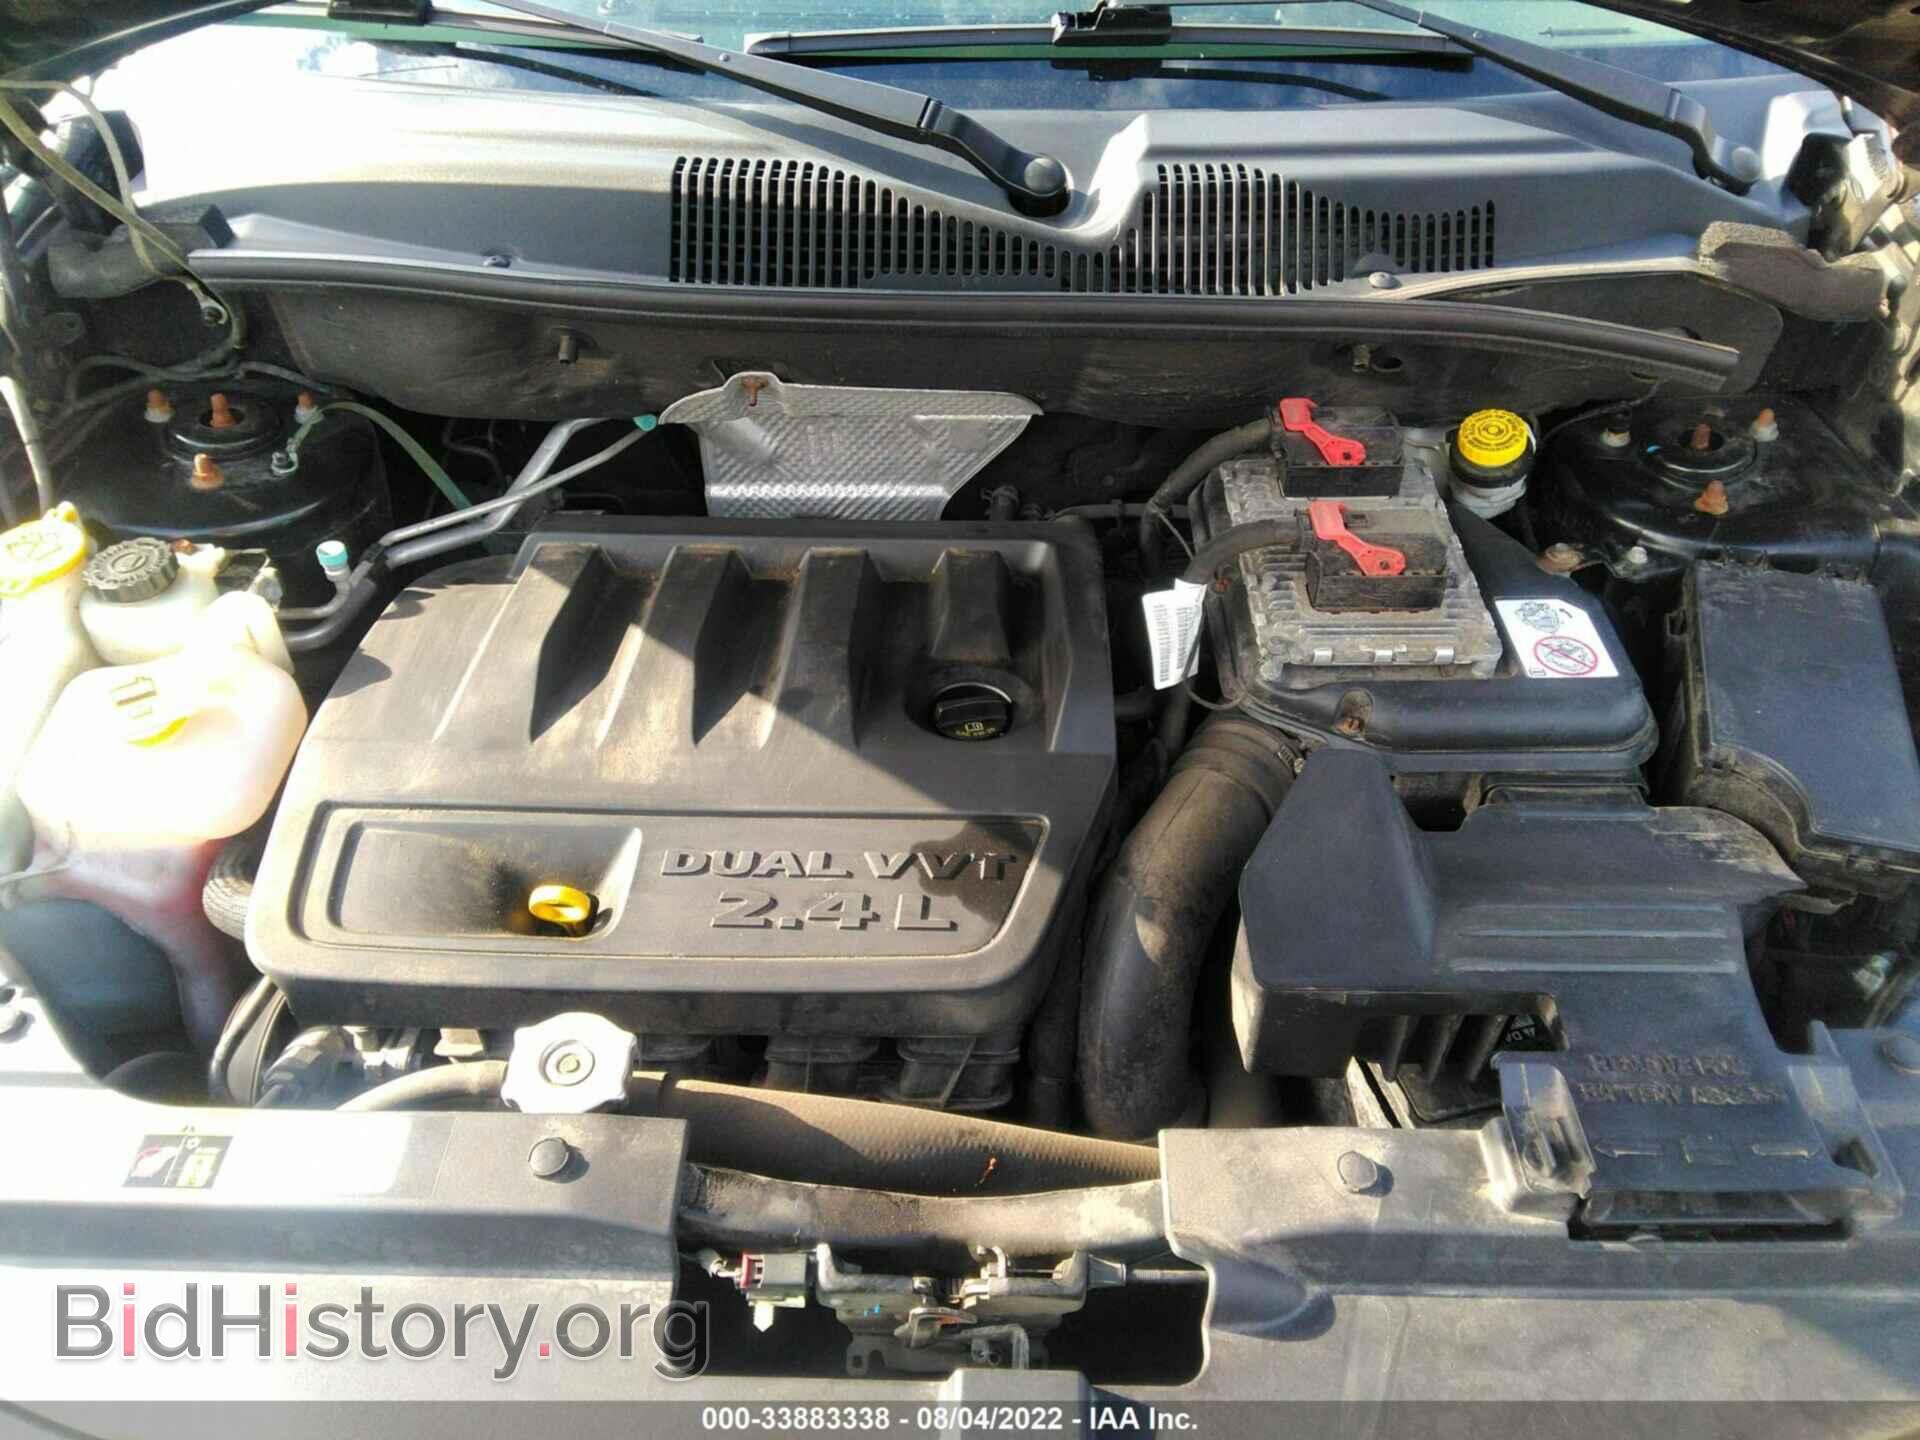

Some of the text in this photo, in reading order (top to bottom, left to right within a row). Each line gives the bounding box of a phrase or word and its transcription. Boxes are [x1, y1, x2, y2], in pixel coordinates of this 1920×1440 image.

[660, 850, 1016, 880] DUAL VVT
[710, 891, 959, 931] 2.4L
